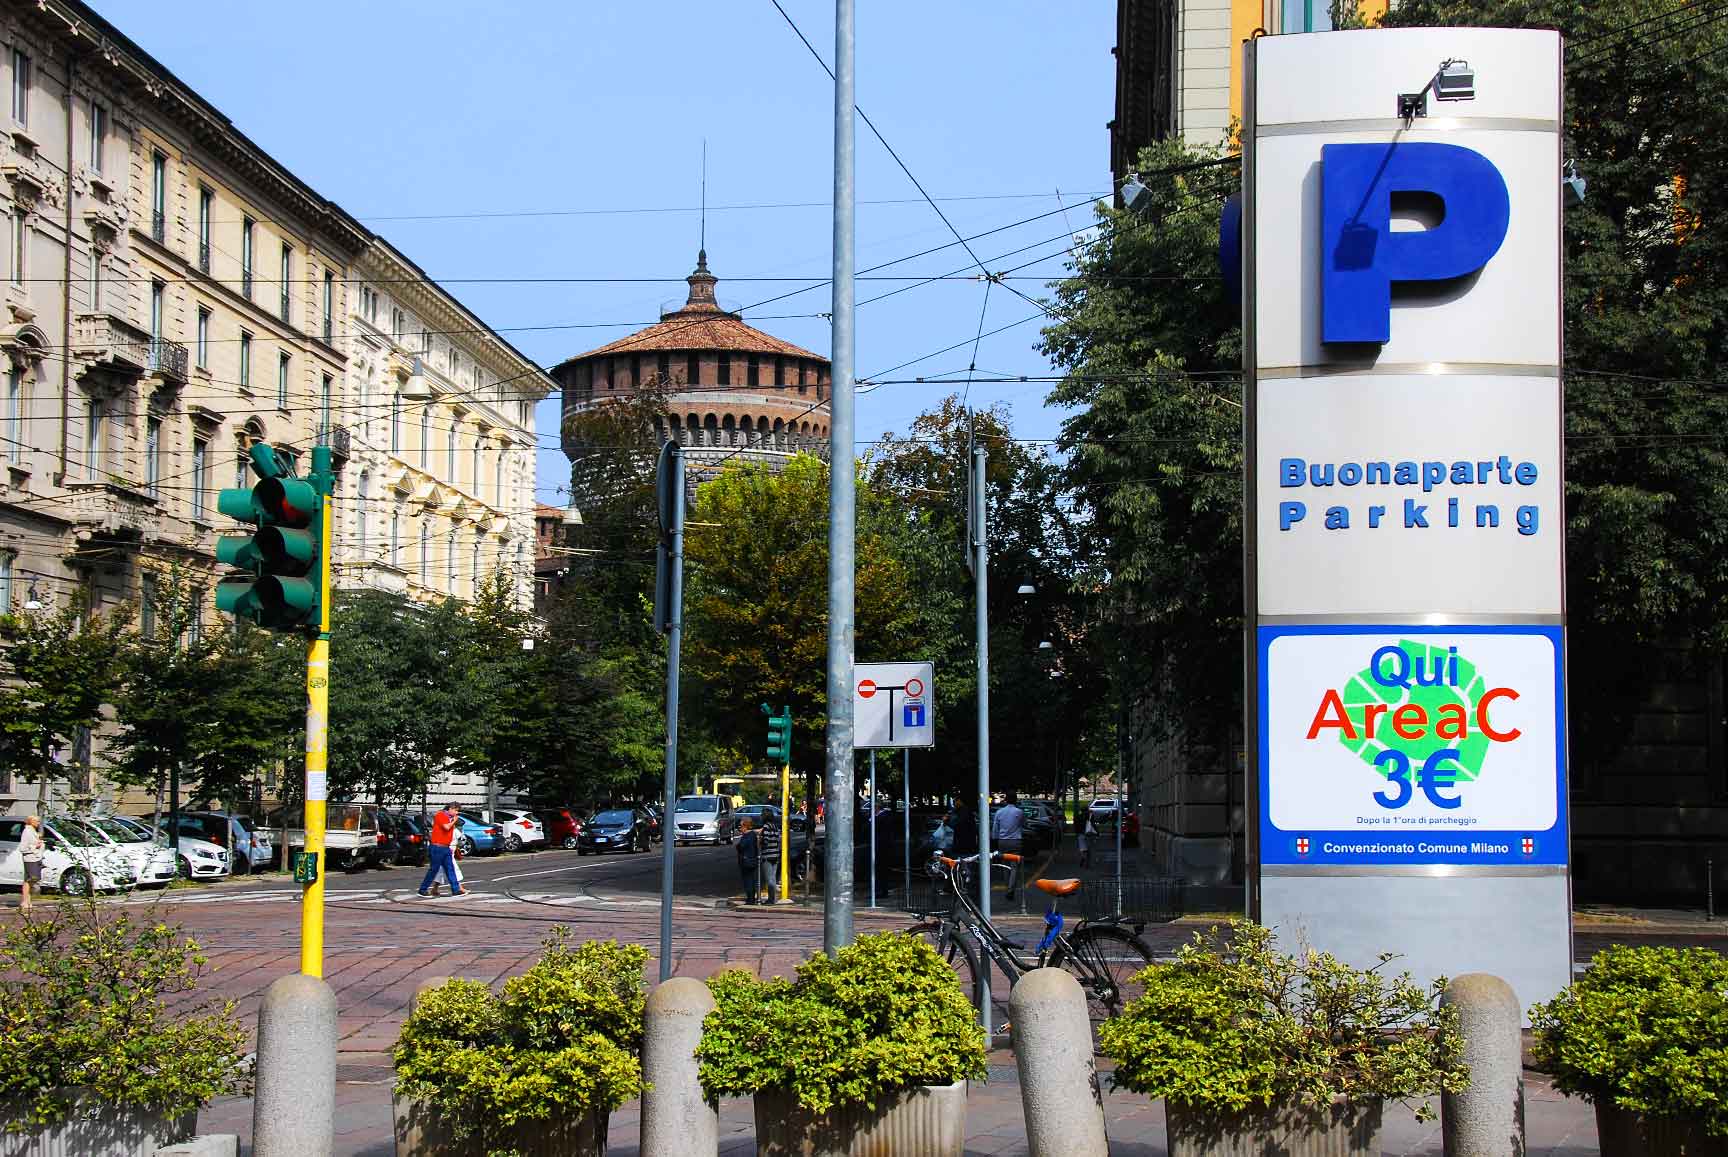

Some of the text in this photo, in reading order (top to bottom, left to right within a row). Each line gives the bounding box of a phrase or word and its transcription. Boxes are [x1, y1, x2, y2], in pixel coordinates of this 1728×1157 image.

[1320, 142, 1510, 345] P
[1279, 456, 1538, 492] Buonaparte
[1279, 498, 1539, 535] Parking
[1370, 645, 1458, 690] Qui
[1372, 748, 1462, 810] 3€
[1356, 816, 1381, 825] Dopo
[1382, 815, 1391, 824] la
[1418, 815, 1427, 824] di
[1429, 816, 1477, 826] parcheggio
[1323, 842, 1509, 854] Convenzionato Comune Milano
